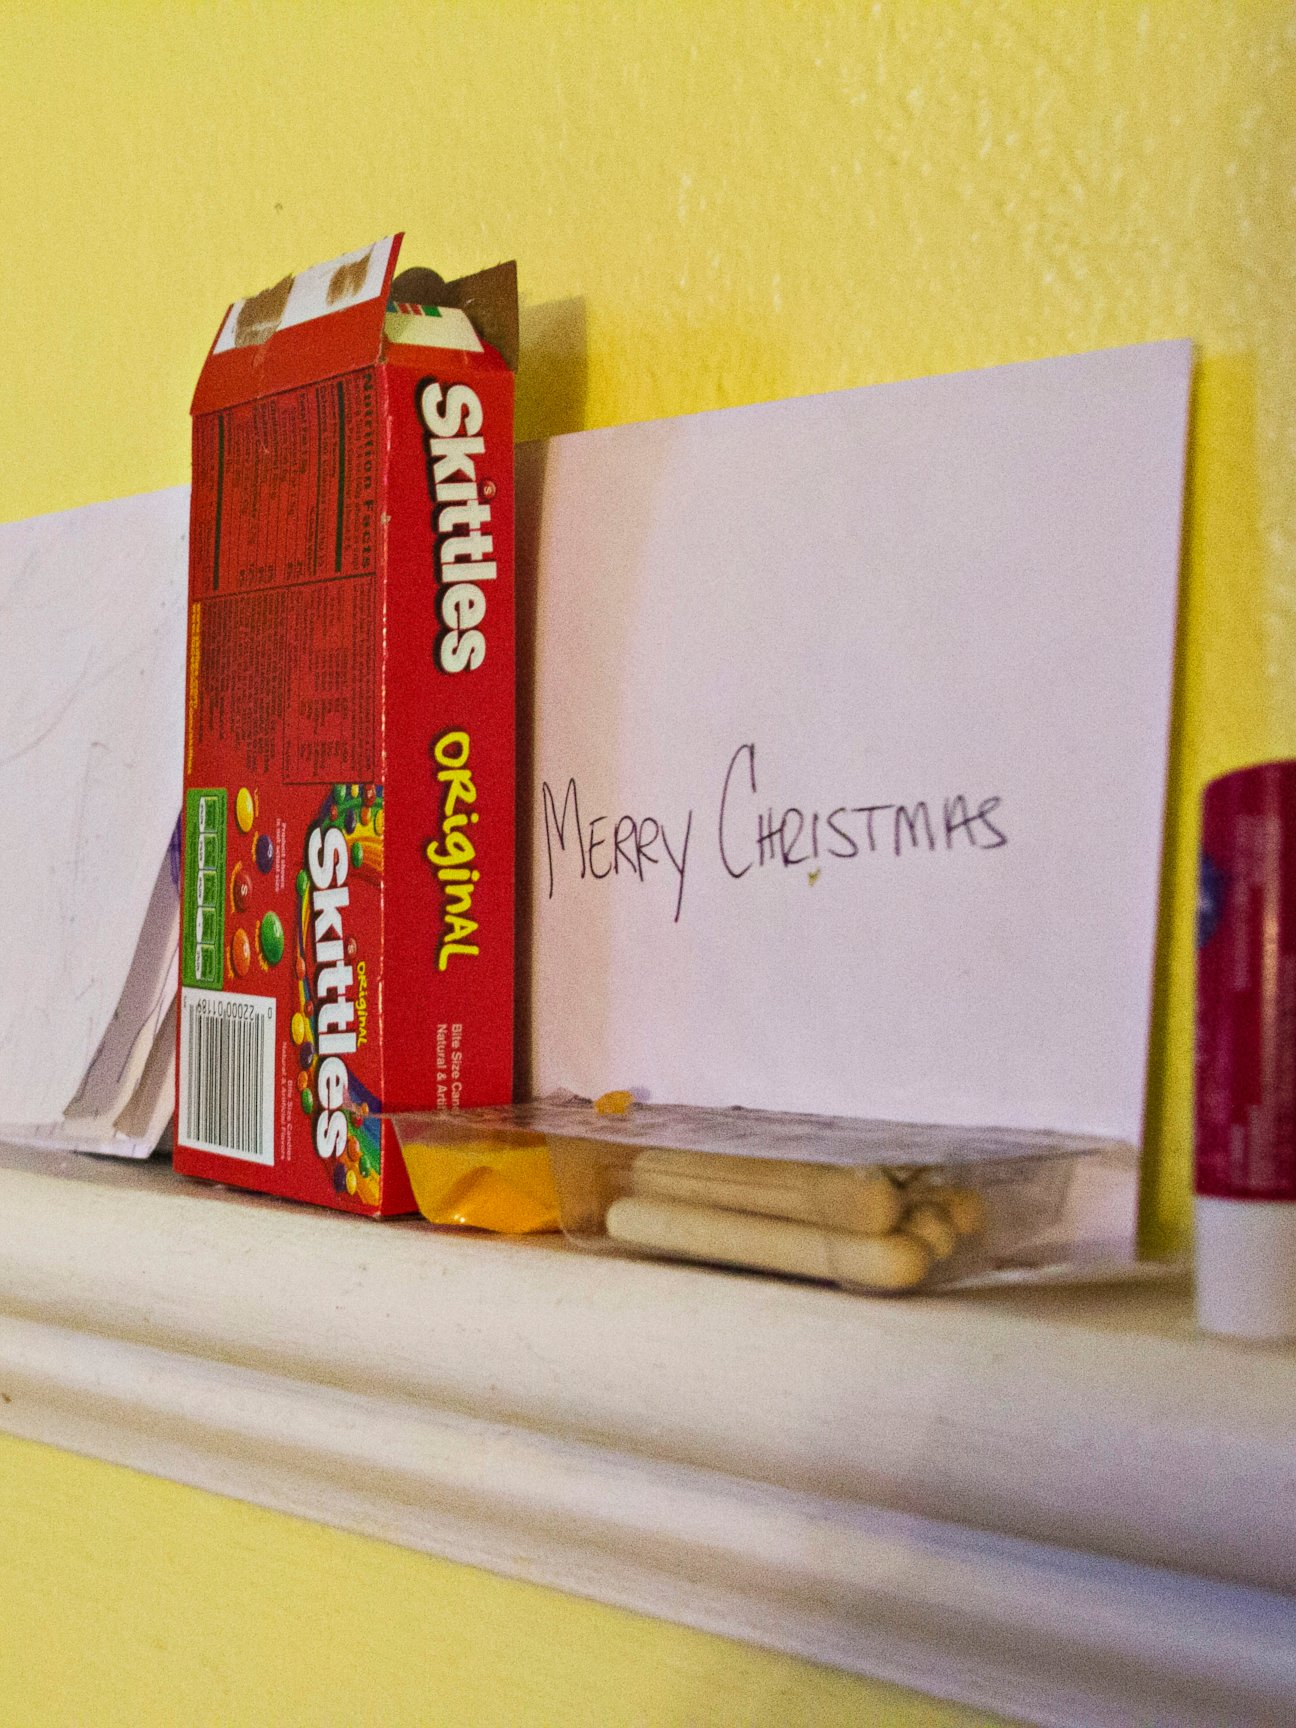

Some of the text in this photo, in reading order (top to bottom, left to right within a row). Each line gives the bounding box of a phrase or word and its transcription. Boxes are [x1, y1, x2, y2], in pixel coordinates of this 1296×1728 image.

[421, 382, 498, 674] Skittles
[308, 827, 358, 1159] Skittles
[436, 1024, 448, 1069] Natural
[451, 1024, 463, 1049] Bite
[436, 1072, 447, 1081] &
[451, 1051, 463, 1079] Size
